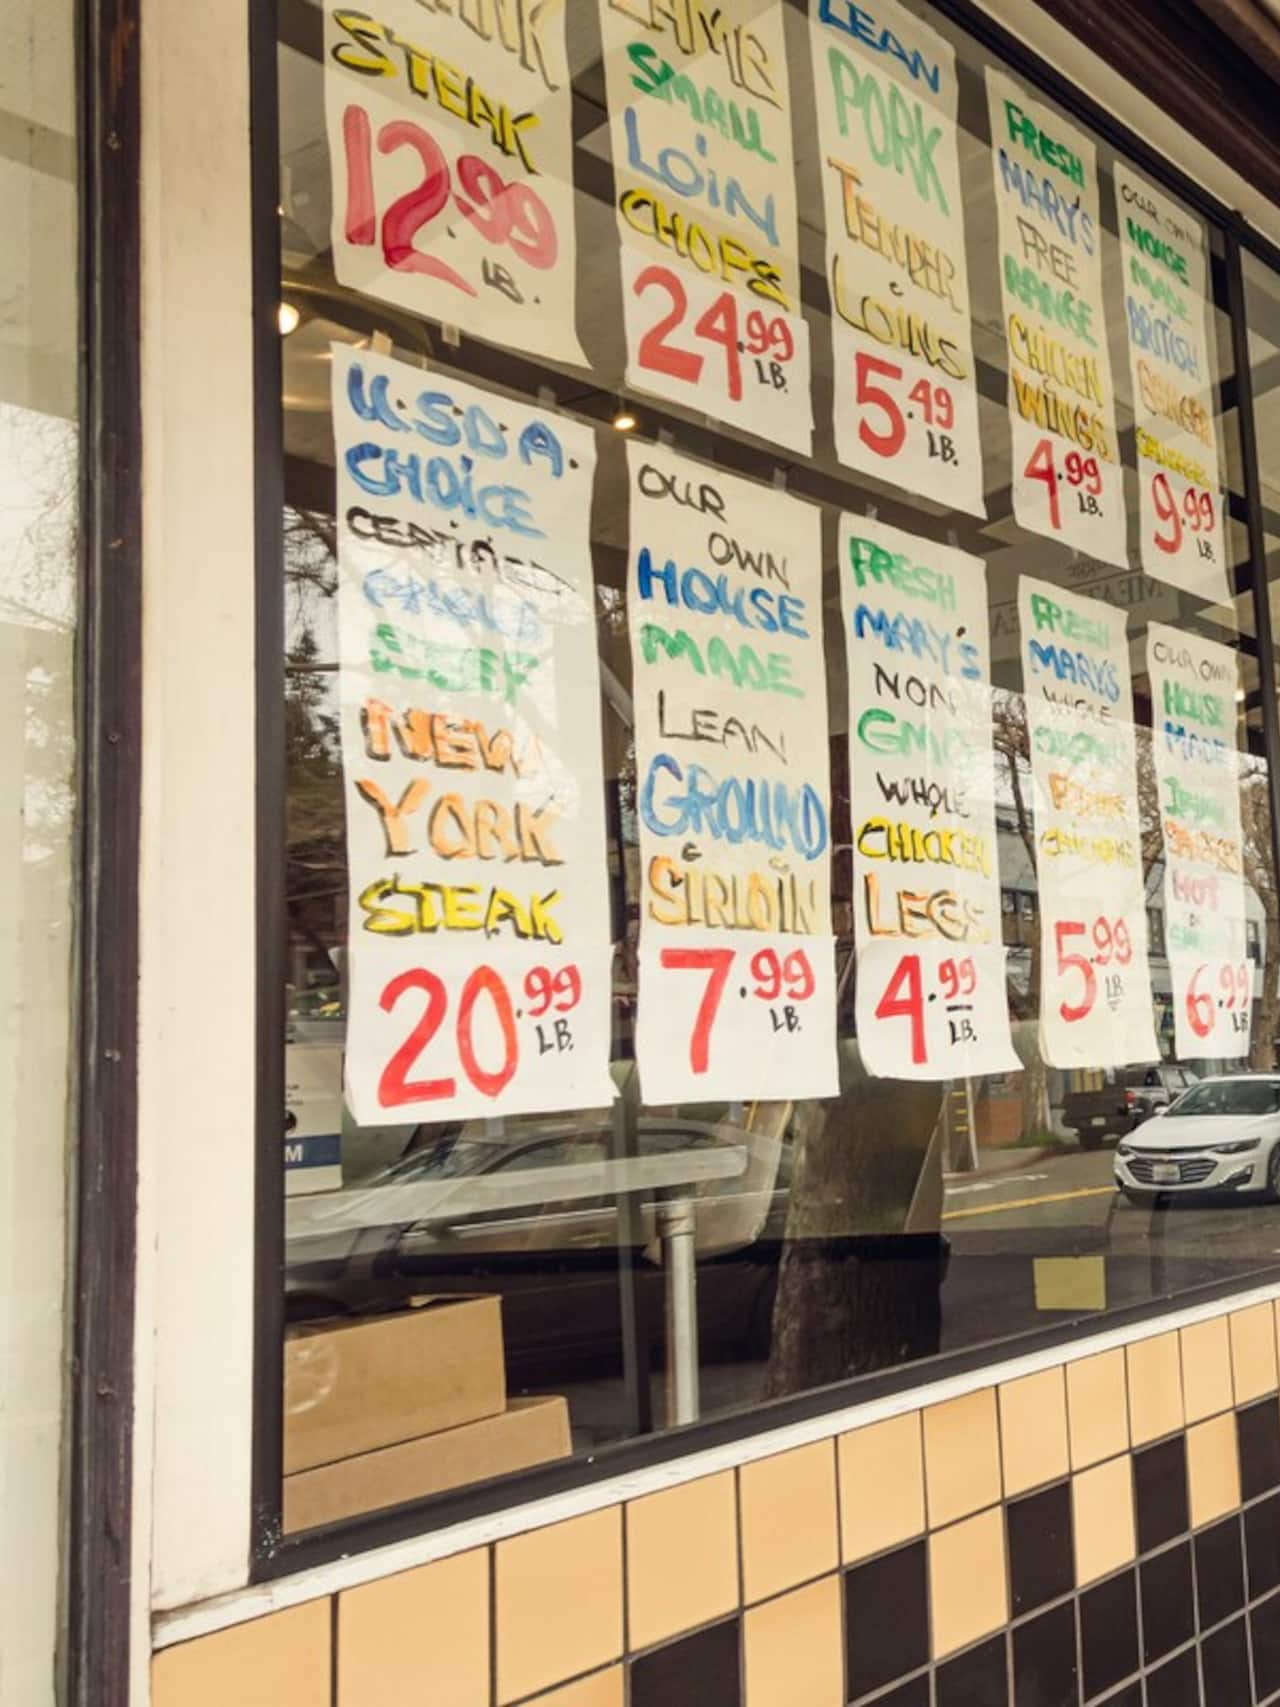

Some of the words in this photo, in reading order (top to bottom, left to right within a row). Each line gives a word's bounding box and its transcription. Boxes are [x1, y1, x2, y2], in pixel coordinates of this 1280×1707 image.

[331, 8, 541, 174] STEAK
[819, 0, 939, 94] LEAN
[626, 42, 777, 163] SMALL
[827, 47, 950, 217] PORK
[1004, 99, 1085, 189] FRESH
[827, 157, 963, 314] TENDER
[999, 146, 1093, 256] MARY'S
[620, 189, 791, 311] CHOPS
[1016, 214, 1079, 290] FREE
[1126, 216, 1190, 288] HOUSE
[634, 265, 795, 402] 24.99
[756, 359, 789, 394] LB.
[855, 351, 955, 458] 5.49
[928, 430, 959, 466] LB.
[638, 463, 727, 522] OUR
[1023, 438, 1103, 531] 4.99
[1077, 492, 1103, 518] LB.
[637, 547, 811, 639] HOUSE
[706, 531, 790, 588] OWN
[849, 535, 957, 612] FRESH
[639, 621, 805, 699] MADE
[657, 689, 788, 765] LEAN
[356, 778, 563, 866] YORK
[639, 752, 827, 861] GROUND
[876, 771, 970, 818] WHOLE
[358, 873, 563, 945] STEAK
[377, 963, 583, 1108] 20.99
[536, 1019, 574, 1056] LB.
[660, 947, 816, 1074] 7.99
[770, 1005, 803, 1034] LB.
